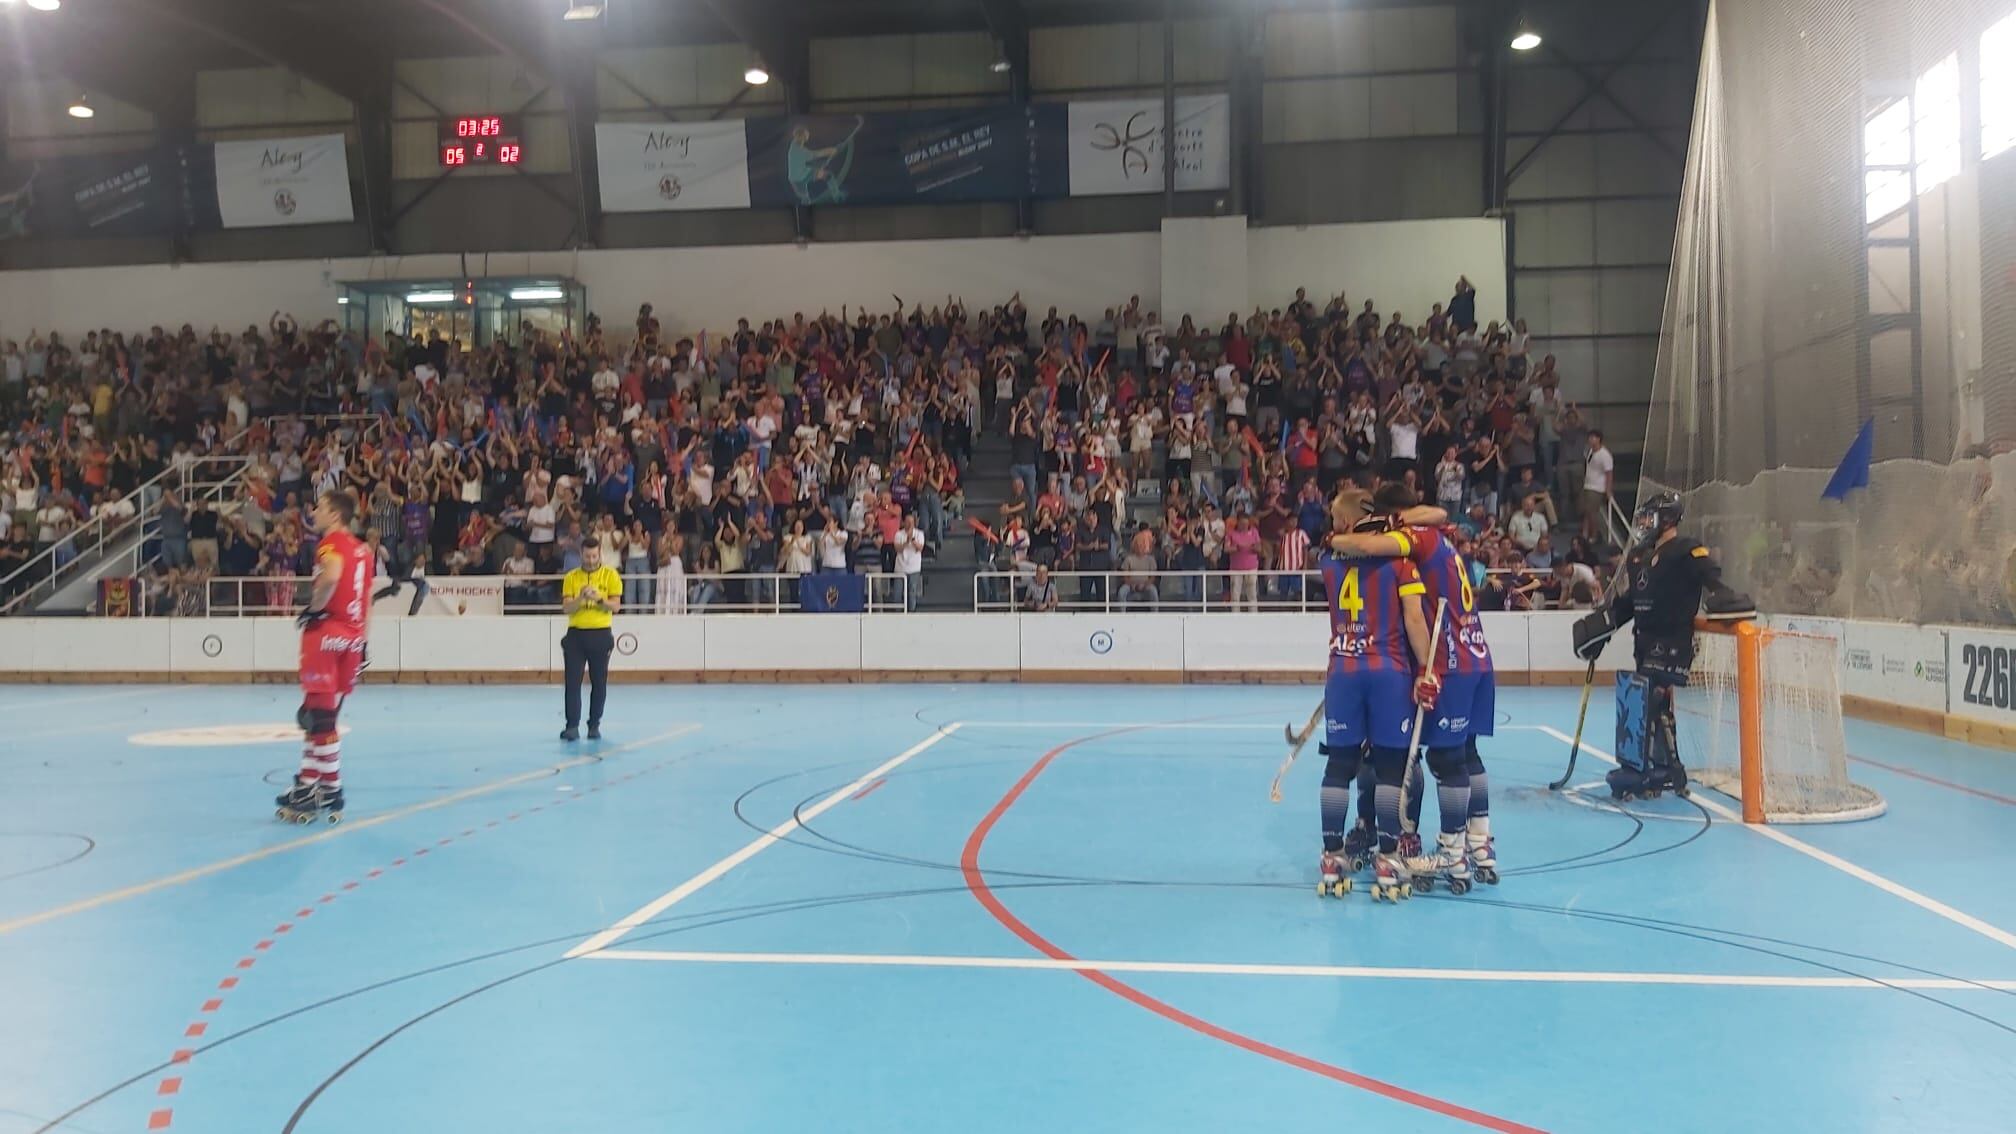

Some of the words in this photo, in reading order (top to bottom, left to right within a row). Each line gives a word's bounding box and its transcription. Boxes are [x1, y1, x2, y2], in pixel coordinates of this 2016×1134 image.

[458, 119, 499, 136] 03:25
[446, 148, 464, 164] 05
[476, 143, 483, 156] 2
[500, 146, 519, 162] 02
[1455, 554, 1473, 612] 8
[456, 587, 500, 596] HOCKEY
[1339, 567, 1364, 622] 4
